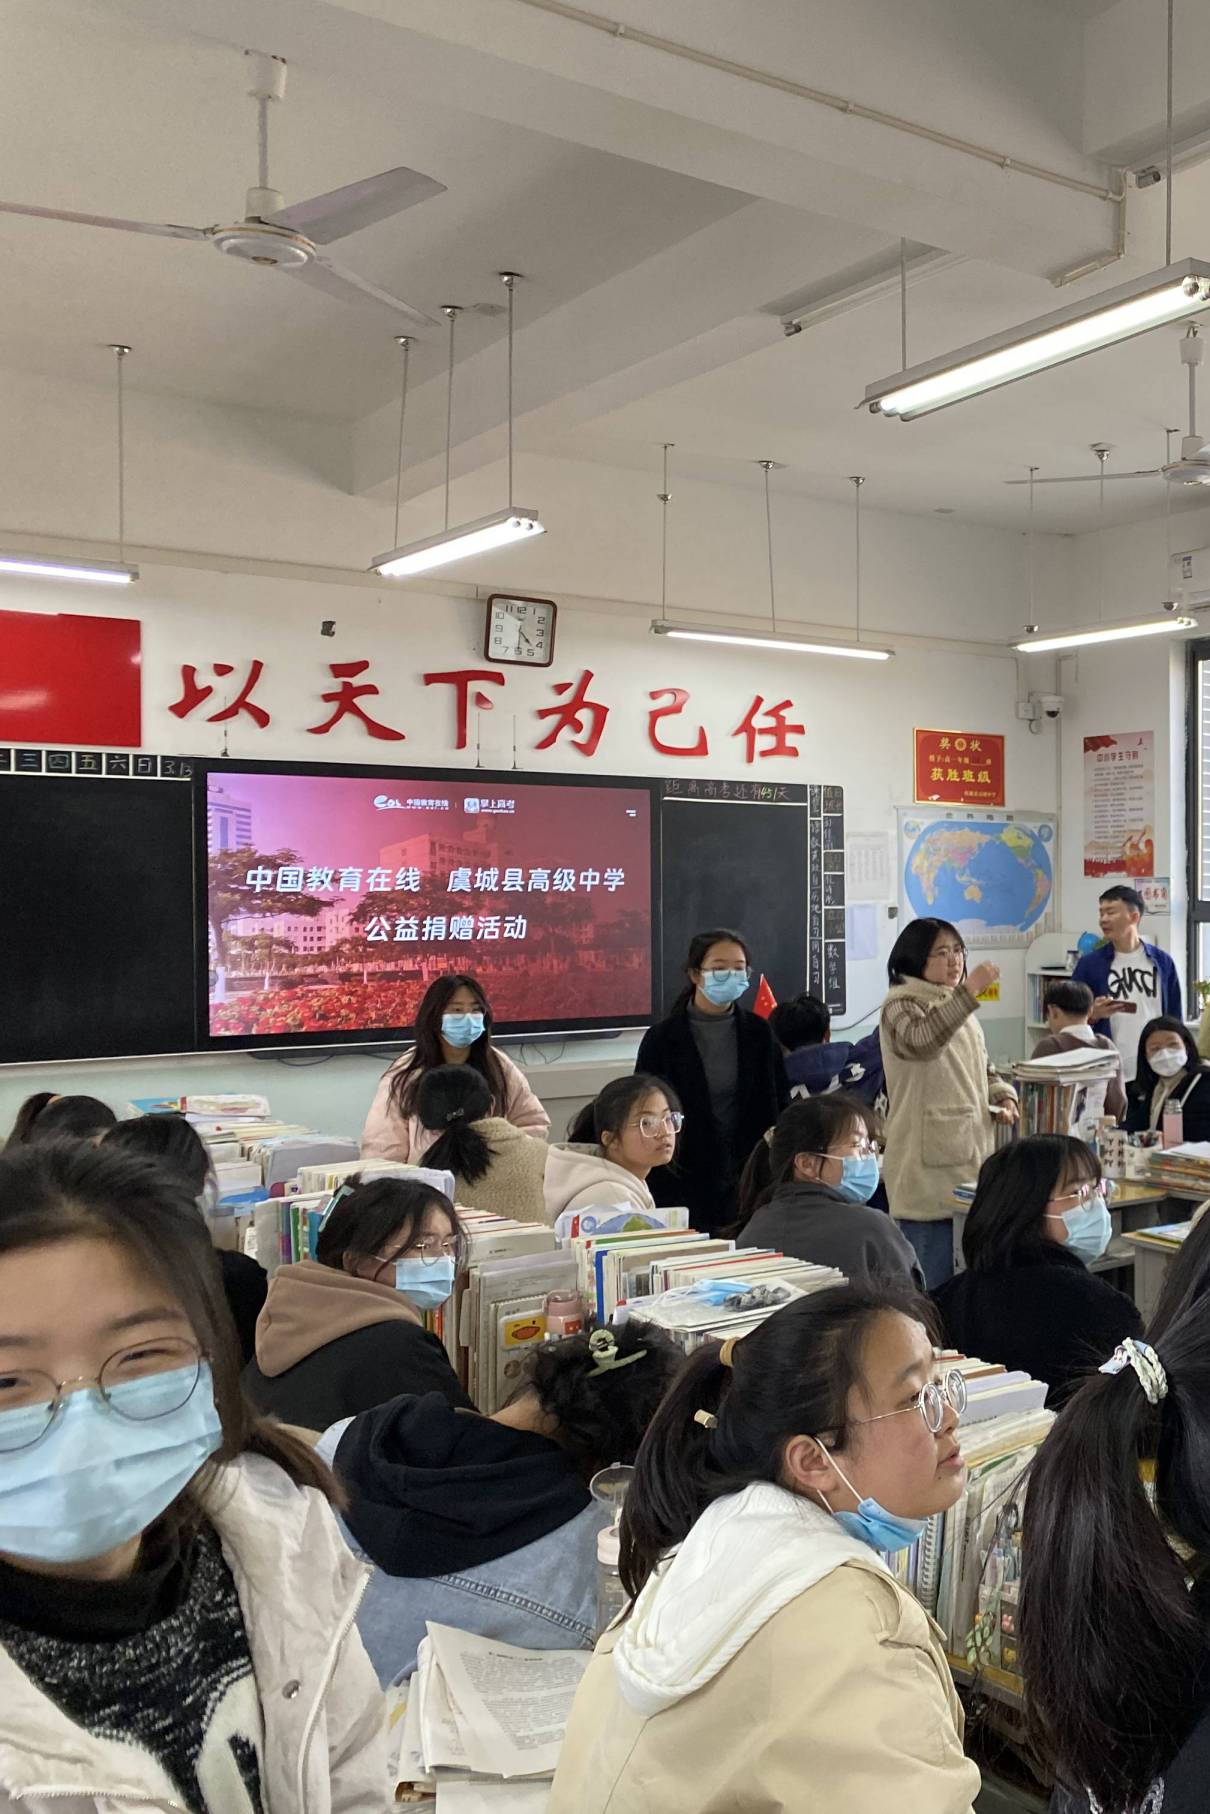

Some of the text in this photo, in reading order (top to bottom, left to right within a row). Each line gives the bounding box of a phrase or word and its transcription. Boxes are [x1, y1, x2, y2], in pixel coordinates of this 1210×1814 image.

[168, 659, 806, 764] 以天下为己任
[21, 753, 39, 768] 三
[49, 753, 70, 769] 四
[79, 754, 97, 770] 五
[109, 755, 127, 770] 六
[138, 757, 151, 774] 日
[930, 767, 991, 784] 获胜班级
[246, 867, 626, 893] 中国教育在线 虞城县高级中学
[364, 915, 528, 943] 公益捐赠活动
